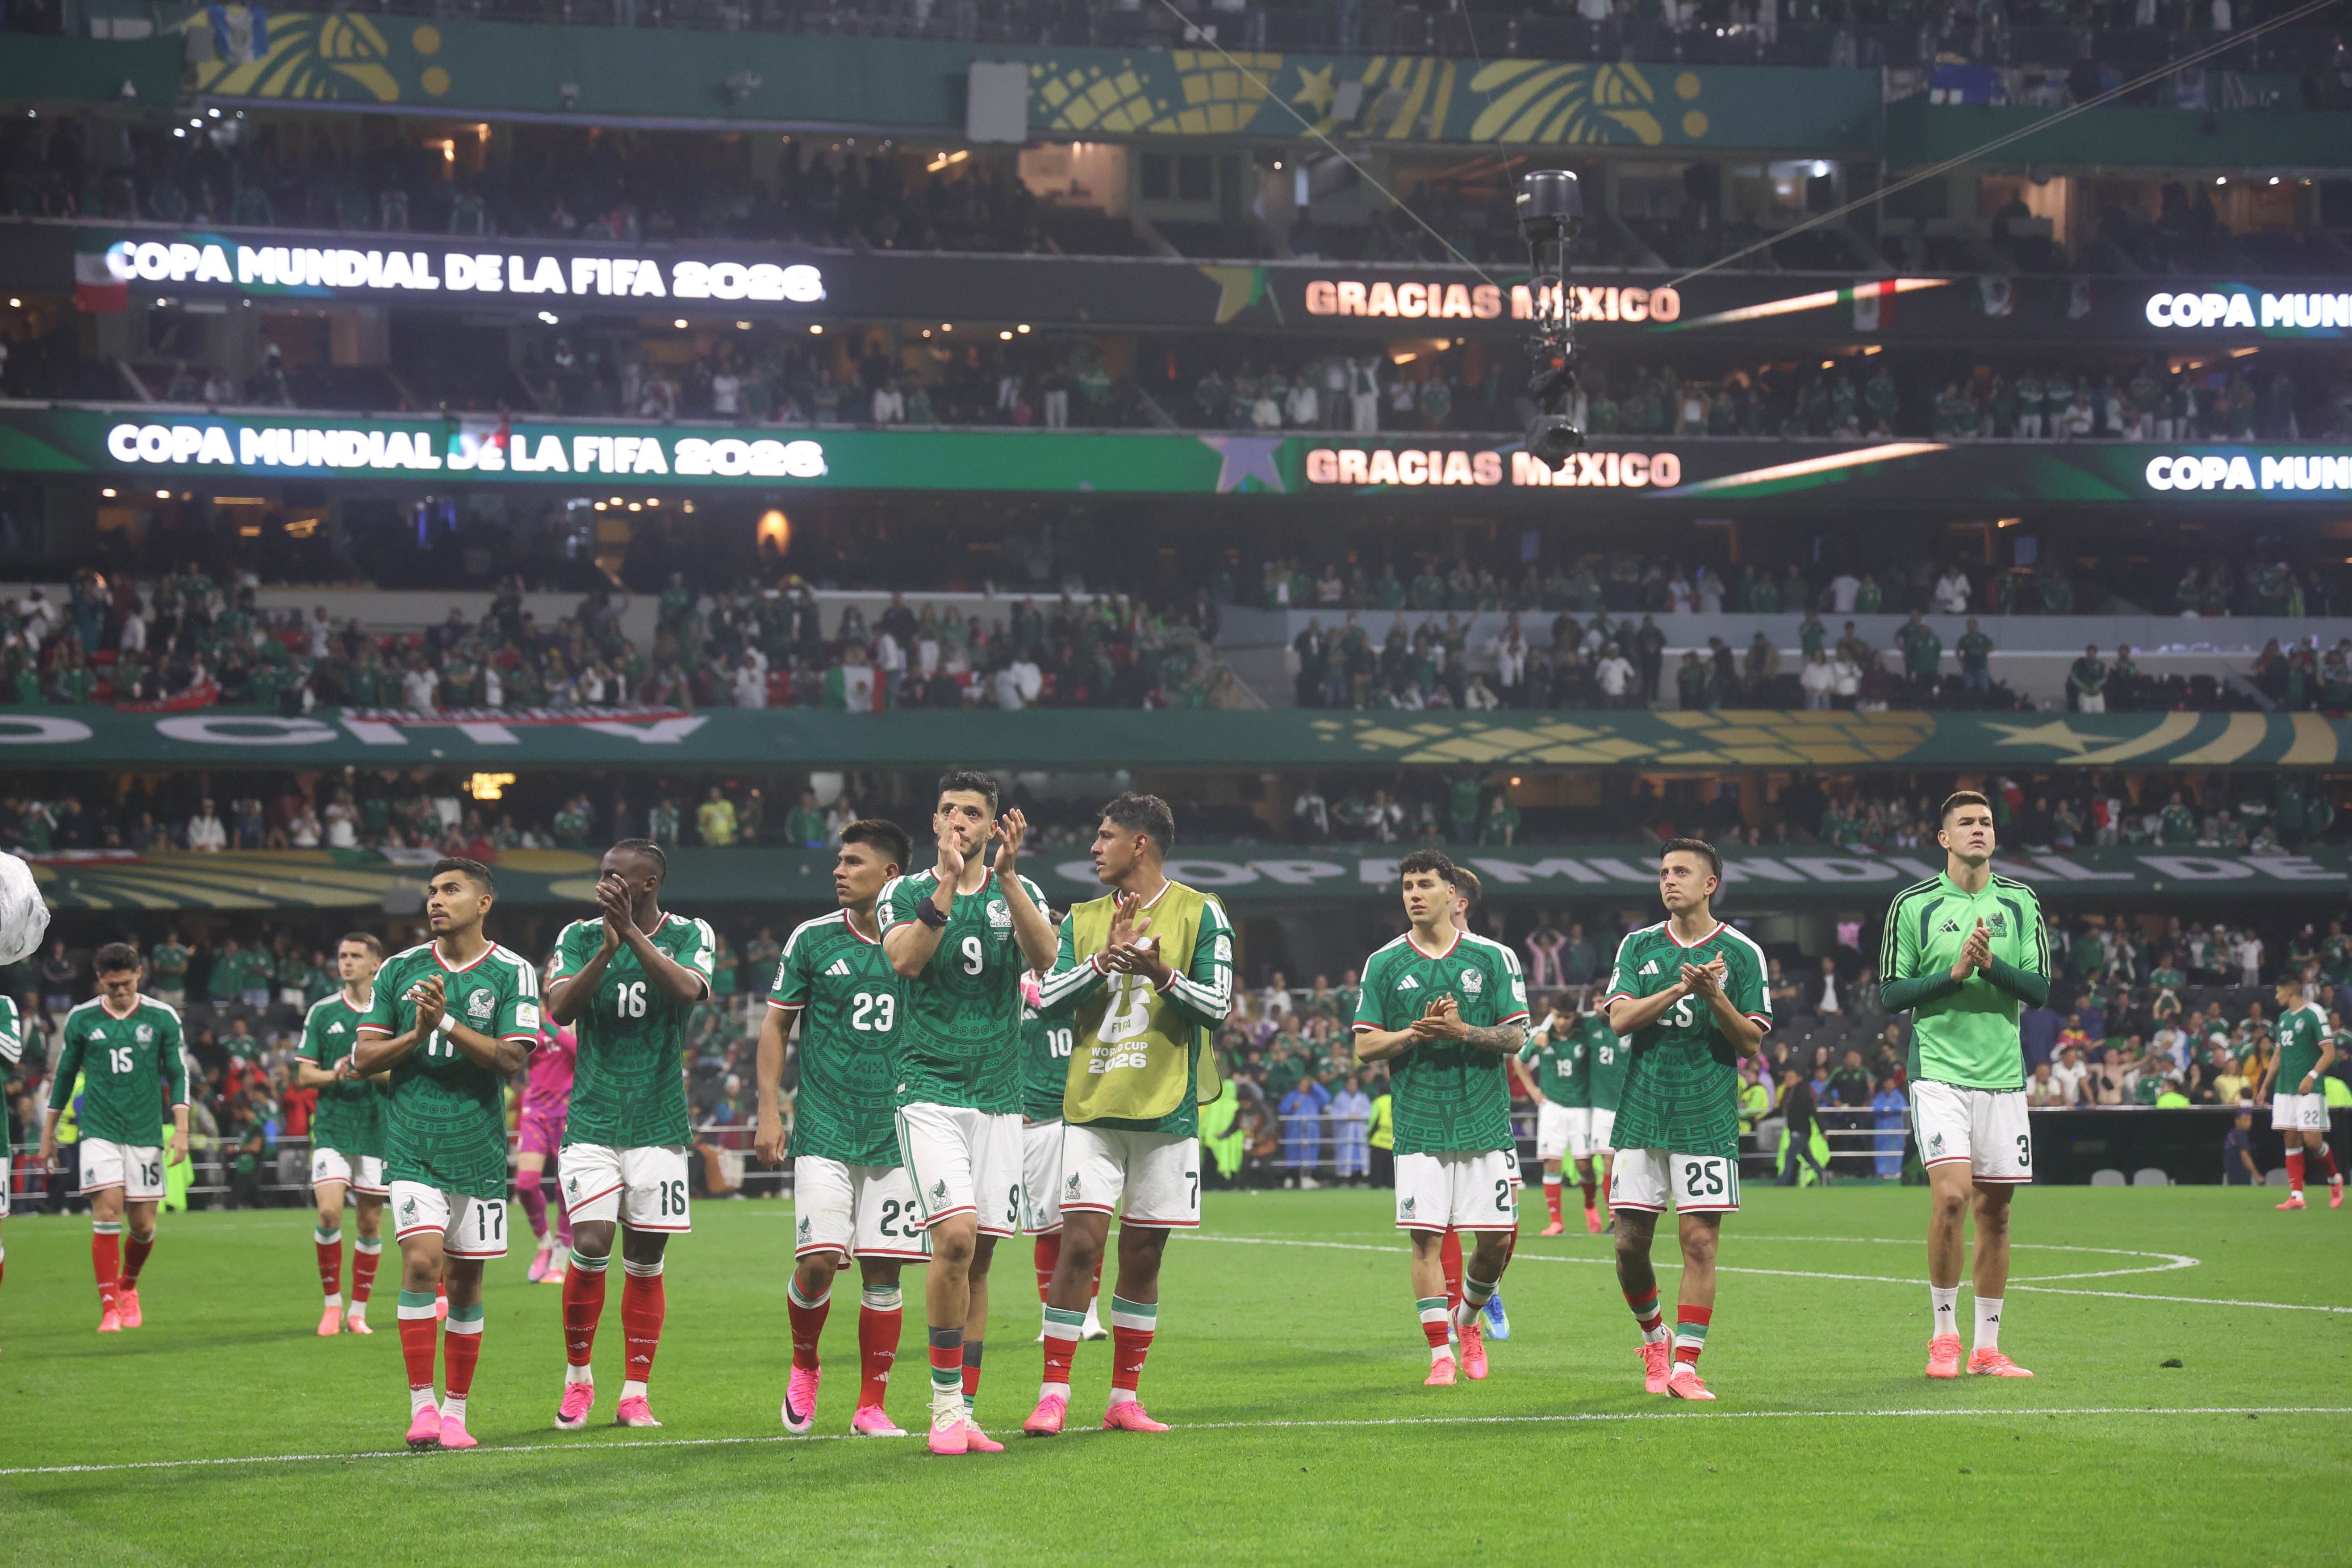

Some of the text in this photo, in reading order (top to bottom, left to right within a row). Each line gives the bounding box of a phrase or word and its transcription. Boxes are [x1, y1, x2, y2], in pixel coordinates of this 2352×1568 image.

[106, 241, 823, 302] COPA MUNDIAL DE LA FIFA 2026
[1306, 280, 1502, 320] GRACIAS
[2146, 292, 2352, 328] COPA MUN
[107, 423, 235, 465] COPA
[240, 427, 442, 470] MUNDIAL
[510, 434, 569, 473] LA
[574, 436, 669, 475] FIFA
[674, 437, 825, 478] 2026
[1306, 448, 1502, 486] GRACIAS
[2146, 455, 2352, 491] COPA MUN
[2136, 855, 2347, 881] DE
[962, 936, 984, 975] 9
[617, 981, 646, 1018] 16
[852, 992, 895, 1031] 23
[1047, 1028, 1073, 1058] 10
[1111, 1019, 1132, 1033] FIFA
[2281, 1030, 2294, 1047] 22
[109, 1047, 134, 1074] 15
[1088, 1053, 1147, 1074] 2026
[1091, 1041, 1148, 1057] WORLD CUP
[1599, 1046, 1614, 1065] 21
[1556, 1059, 1572, 1077] 19
[2304, 1109, 2319, 1125] 22
[2017, 1134, 2030, 1167] 3
[141, 1163, 160, 1186] 15
[1185, 1172, 1197, 1209] 7
[1685, 1160, 1723, 1197] 25
[660, 1180, 685, 1216] 16
[1007, 1184, 1019, 1222] 9
[1496, 1179, 1510, 1211] 2
[477, 1202, 502, 1241] 17
[881, 1199, 919, 1238] 23
